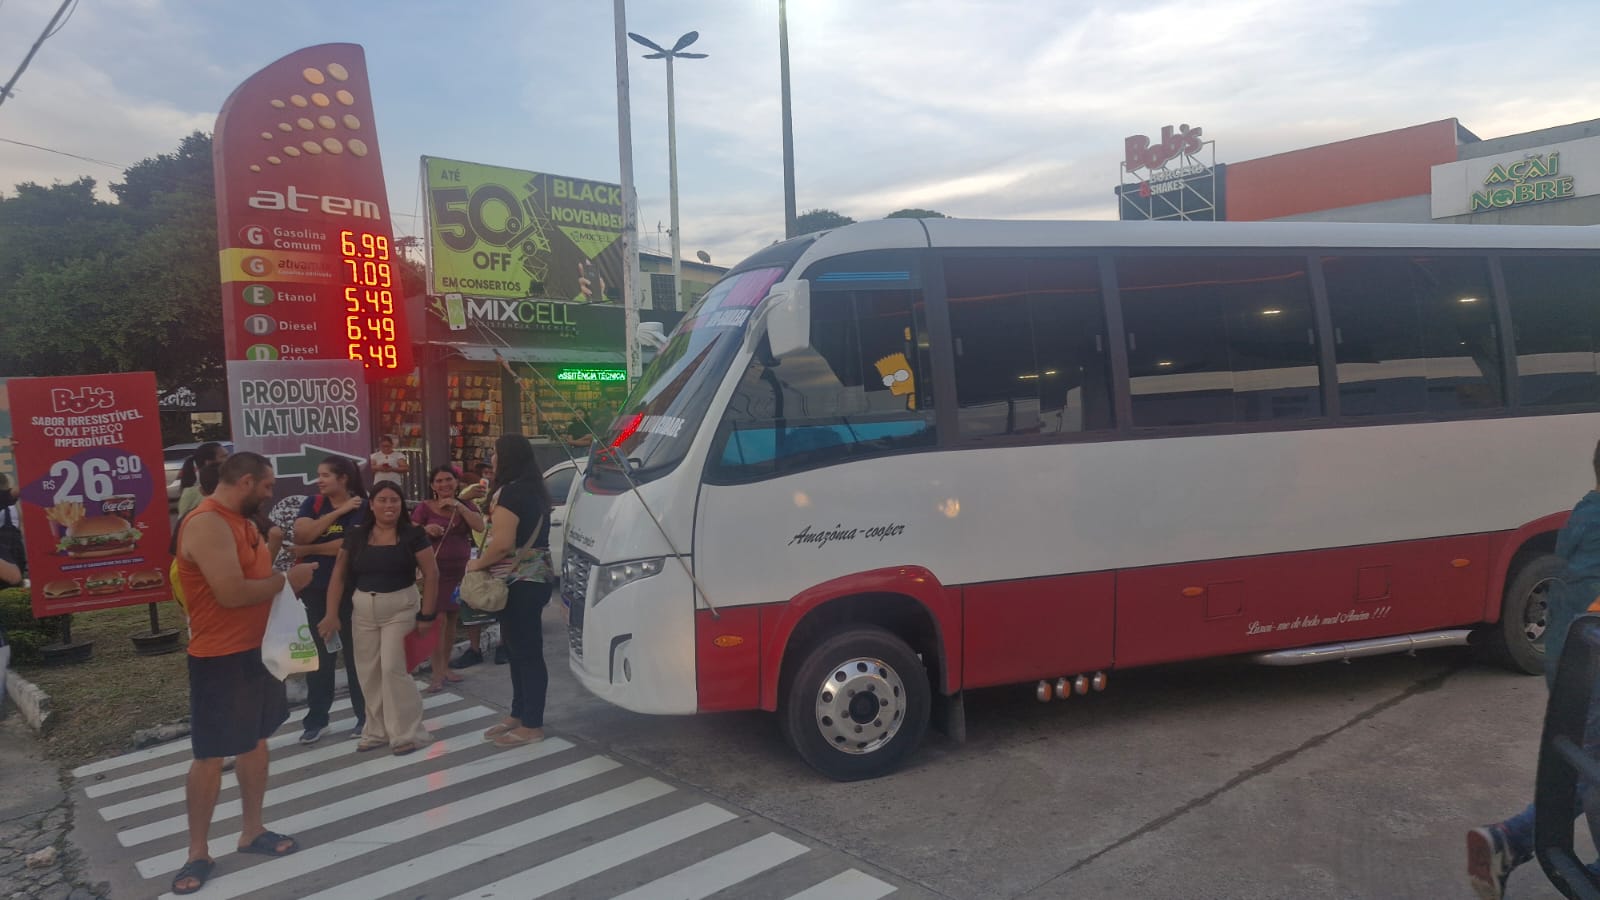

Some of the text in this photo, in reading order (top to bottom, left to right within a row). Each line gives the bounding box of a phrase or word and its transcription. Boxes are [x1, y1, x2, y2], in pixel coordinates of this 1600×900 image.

[1125, 124, 1202, 173] Bob's
[441, 168, 461, 181] ATÉ
[1482, 150, 1560, 184] AÇAÍ
[553, 178, 621, 206] BLACK
[1151, 180, 1185, 195] SHAKES
[1470, 176, 1575, 211] NOBRE
[249, 186, 381, 220] atem
[247, 227, 264, 245] G
[273, 227, 326, 240] Gasolina
[274, 239, 321, 251] Comum
[341, 231, 389, 260] 6.99
[473, 251, 512, 272] OFF
[344, 260, 391, 287] 7.09
[442, 277, 521, 292] EM CONSERTOS
[253, 286, 265, 304] E
[277, 292, 316, 303] Etanol
[345, 288, 393, 314] 5.49
[467, 299, 577, 325] MIXCELL
[254, 317, 269, 334] D
[279, 321, 317, 332] Diesel
[346, 316, 396, 341] 6.49
[280, 344, 318, 355] Diesel
[51, 387, 115, 413] Bob's
[240, 377, 358, 406] PRODUTOS
[32, 409, 144, 426] SABOR IRRESISTÍVEL
[243, 405, 361, 437] NATURAIS
[43, 423, 123, 437] COM PREÇO
[54, 434, 125, 448] IMPERDÍVEL!
